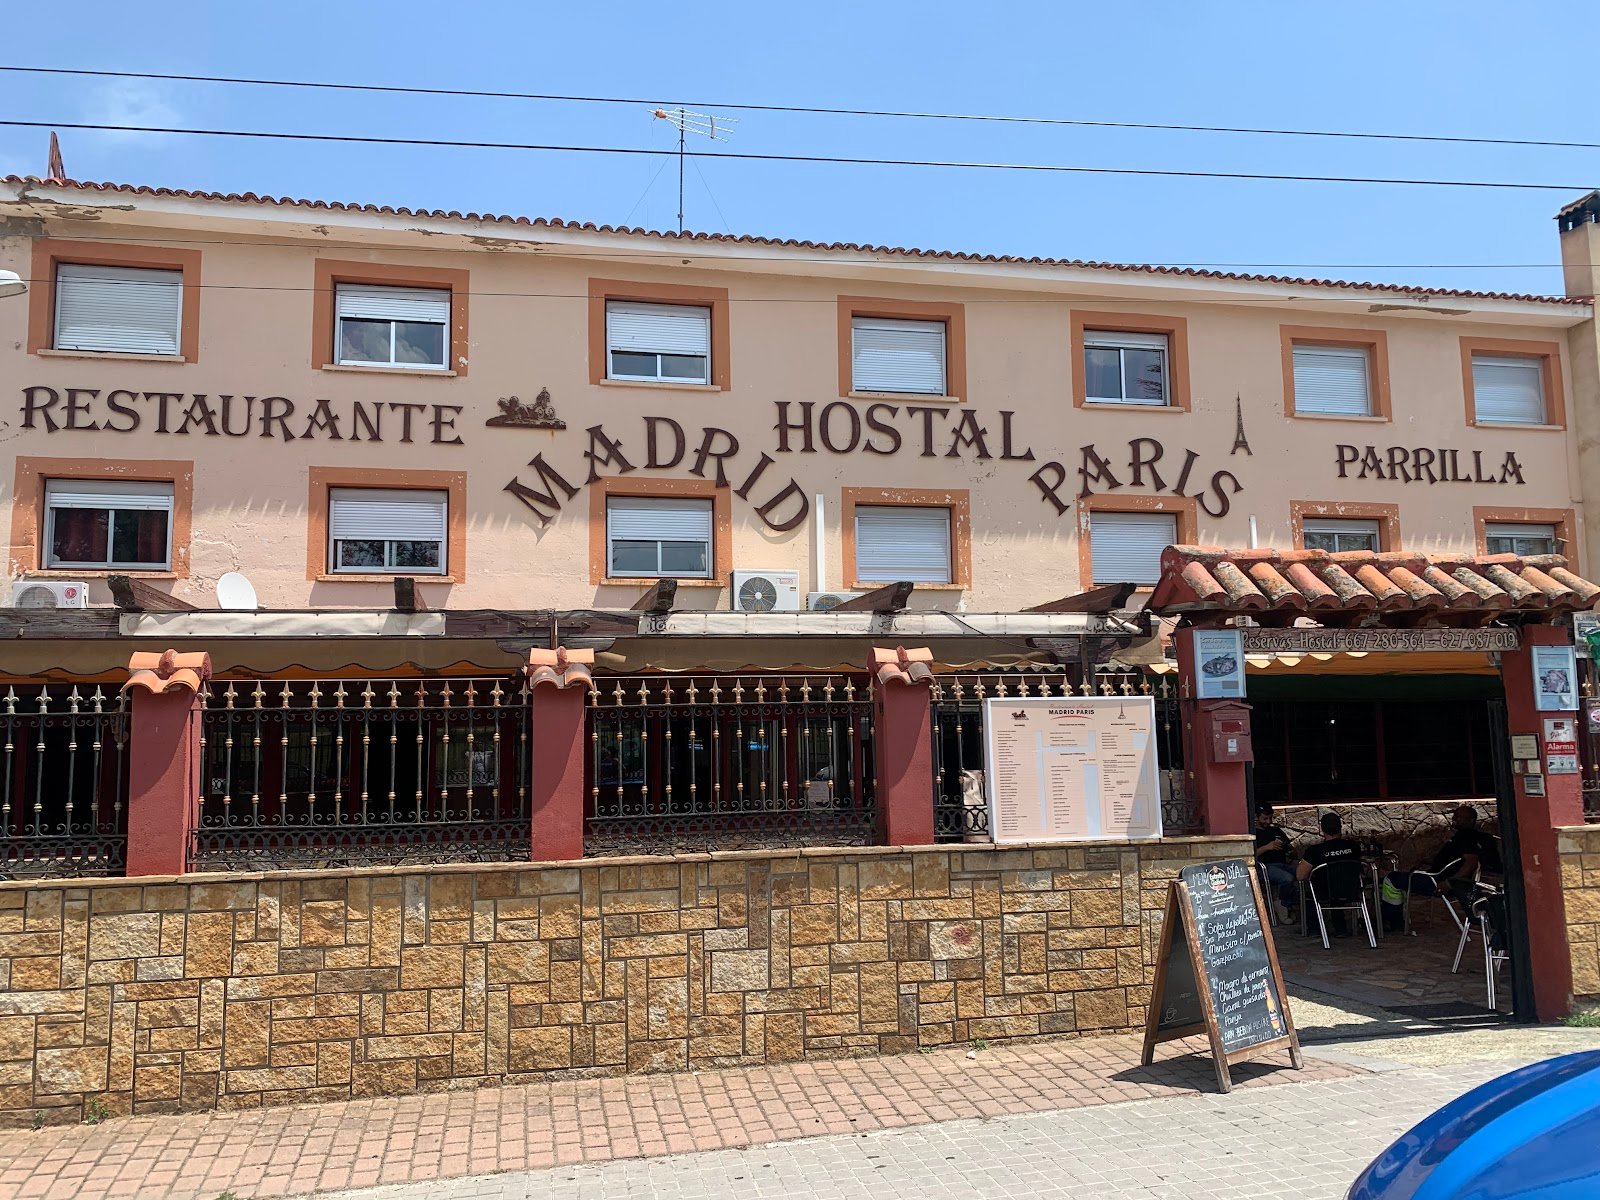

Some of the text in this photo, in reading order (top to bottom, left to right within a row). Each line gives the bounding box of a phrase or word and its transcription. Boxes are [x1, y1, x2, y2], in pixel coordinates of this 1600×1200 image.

[19, 385, 465, 445] RESTAURANTE
[772, 401, 1036, 461] HOSTAL
[502, 415, 810, 532] MADRID
[1028, 437, 1244, 518] PARIS
[1335, 444, 1526, 485] PARRILLA
[1345, 633, 1369, 650] 667
[1373, 633, 1398, 650] 280
[1401, 633, 1426, 650] 564
[1440, 633, 1463, 650] 627
[1467, 633, 1492, 649] 087
[1495, 633, 1518, 648] 019
